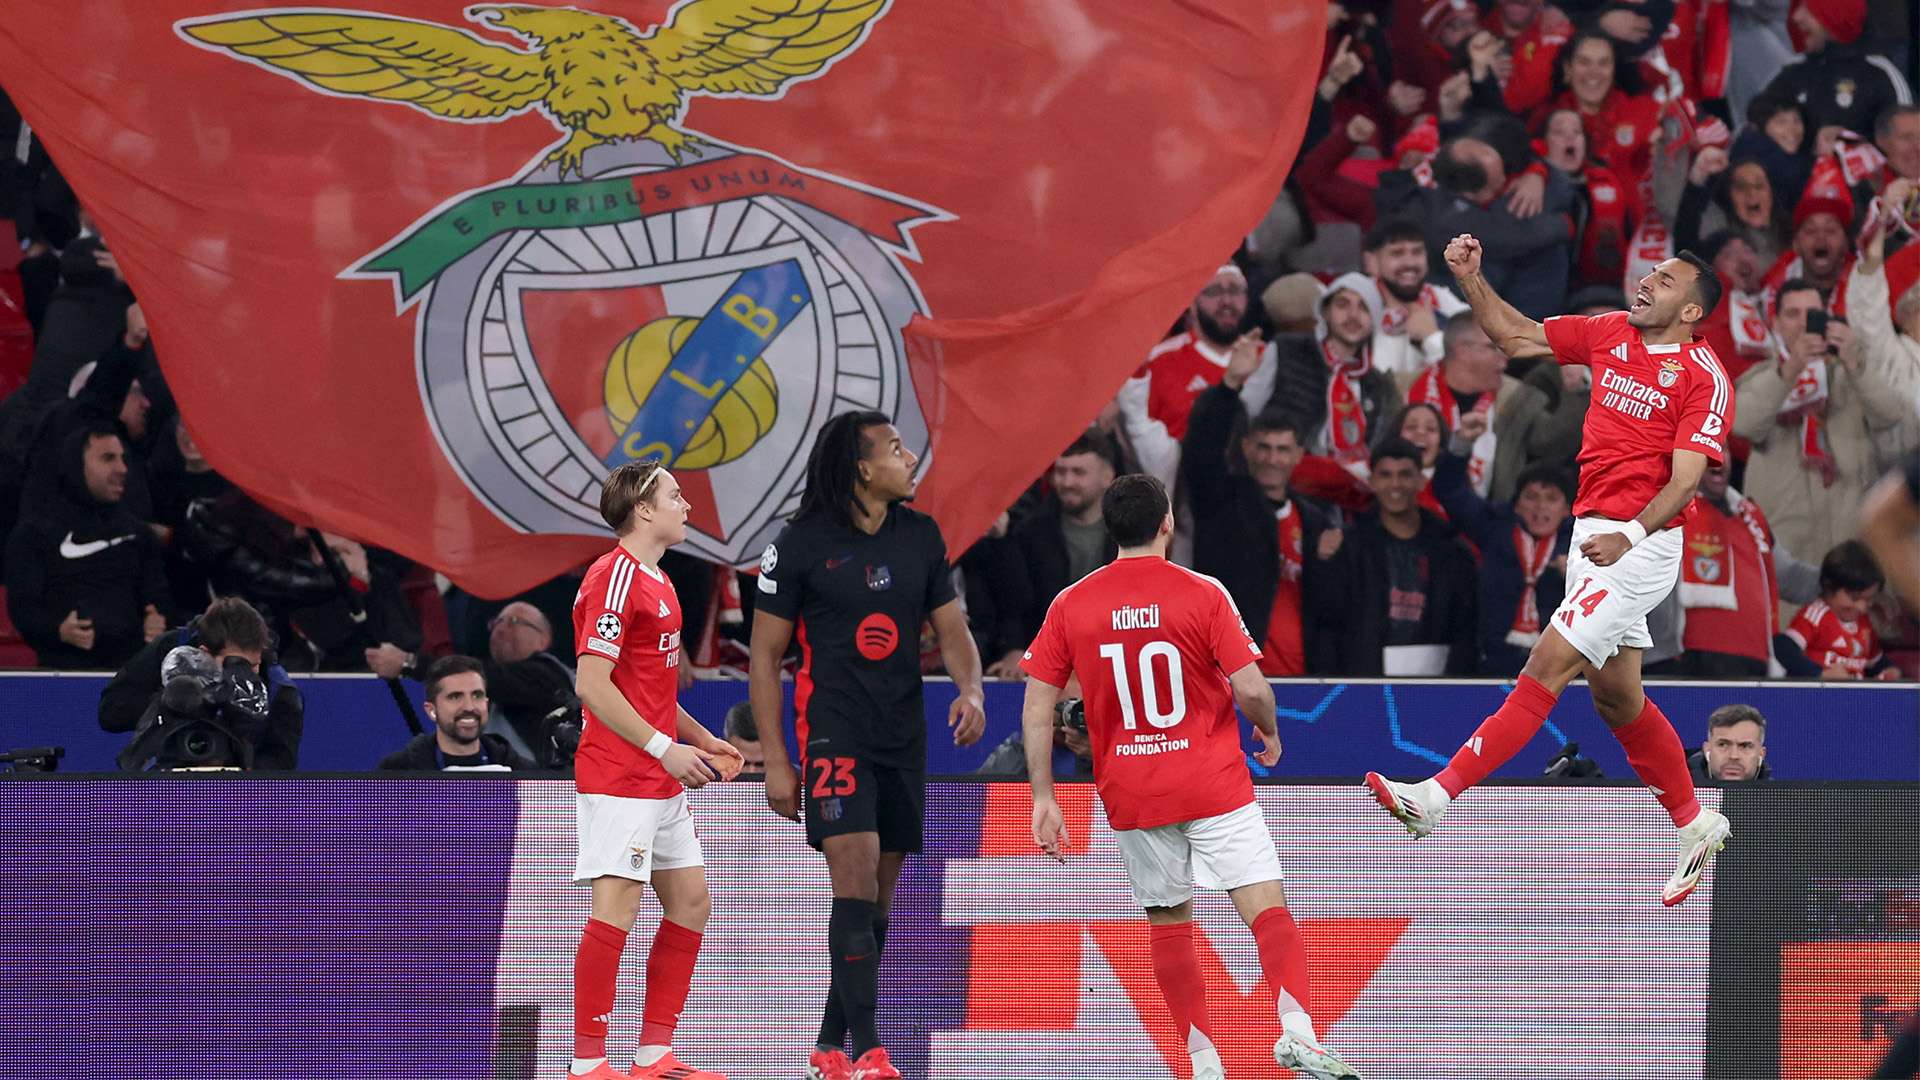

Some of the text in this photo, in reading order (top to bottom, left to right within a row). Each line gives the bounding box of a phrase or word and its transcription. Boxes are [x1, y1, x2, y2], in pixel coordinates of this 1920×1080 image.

[453, 169, 807, 236] E PLURIBUS UNUM
[1600, 367, 1669, 410] Emirates
[1601, 391, 1652, 421] FLY BETTER
[1569, 576, 1609, 617] 14
[1100, 641, 1187, 730] 10
[1116, 738, 1189, 756] FOUNDATION
[1134, 733, 1167, 743] BENFCA
[812, 756, 856, 798] 23
